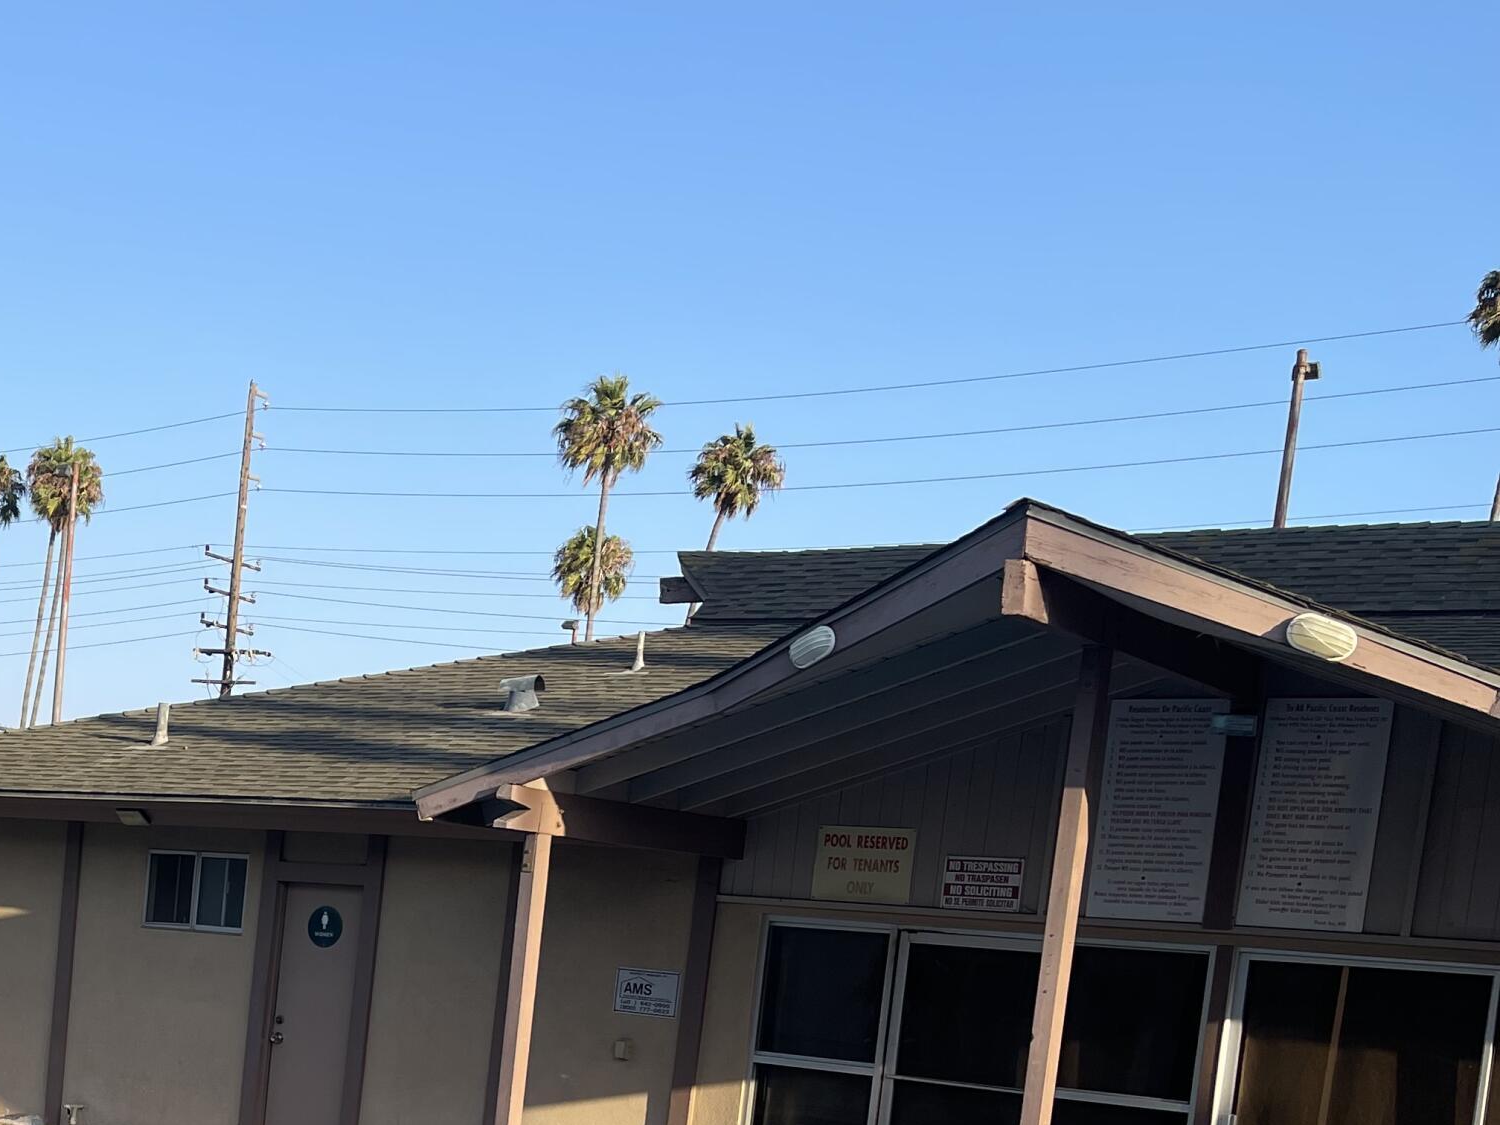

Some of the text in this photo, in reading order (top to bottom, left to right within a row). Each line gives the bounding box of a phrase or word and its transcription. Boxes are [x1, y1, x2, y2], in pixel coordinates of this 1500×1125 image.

[824, 834, 909, 850] POOL RESERVED
[827, 857, 900, 873] FOR TENANTS
[948, 860, 1019, 873] NO TRESPASSING
[955, 874, 1010, 884] NO TRASPASEN
[846, 881, 875, 895] ONLY
[950, 884, 1013, 898] NO SOLICITING
[624, 982, 653, 996] AMS
